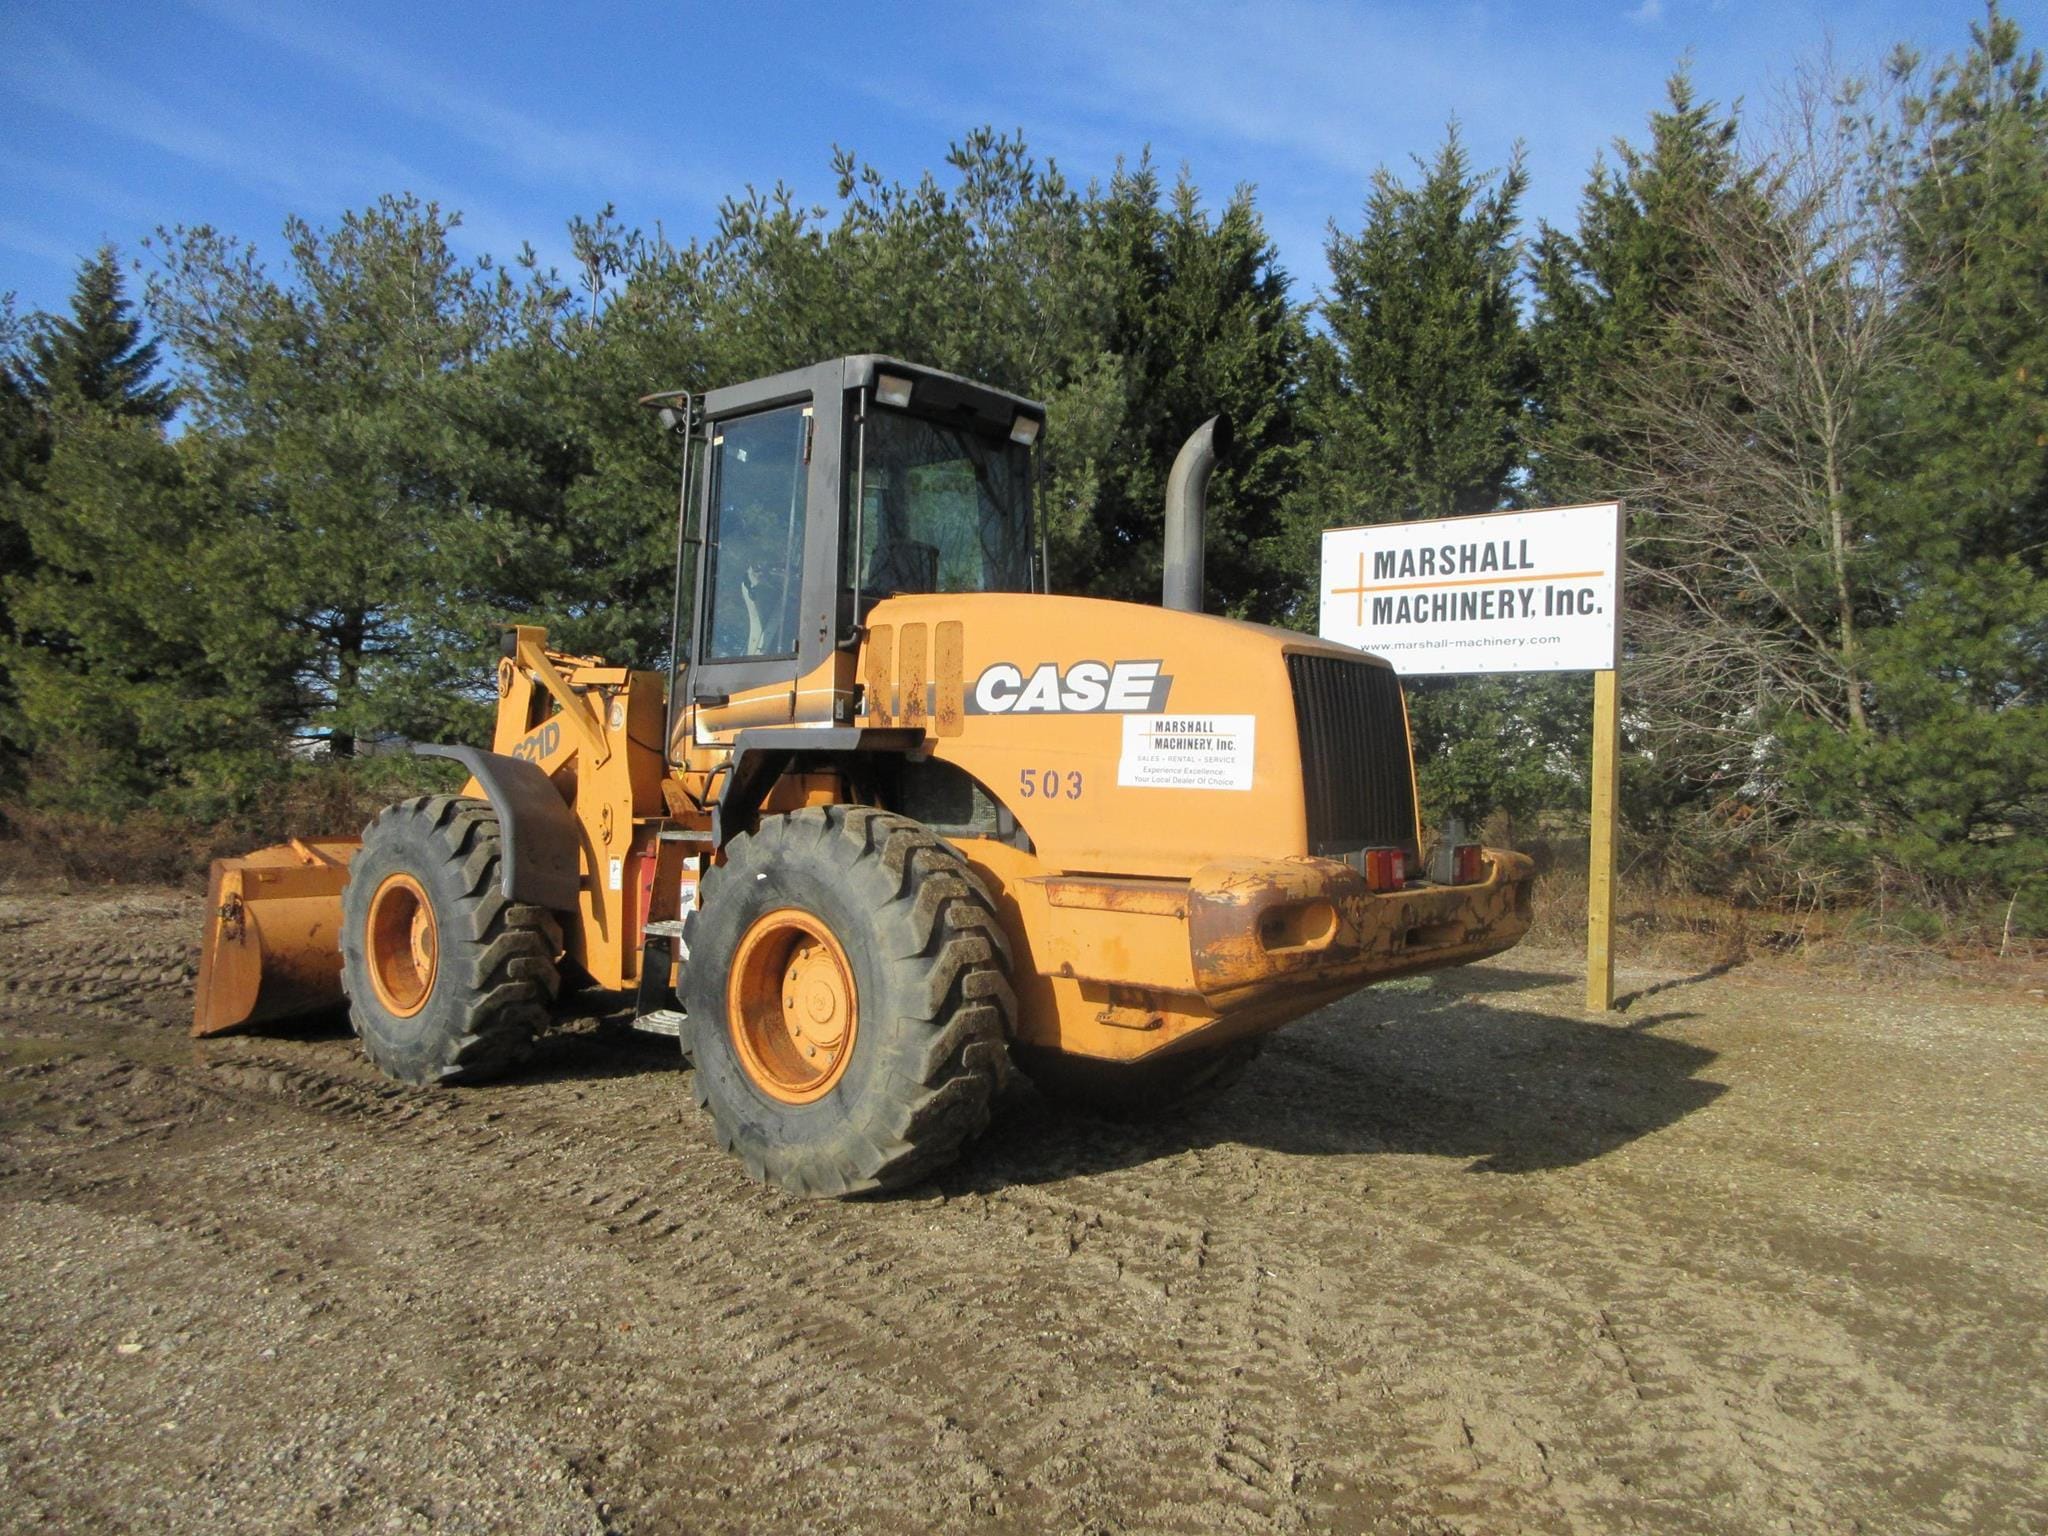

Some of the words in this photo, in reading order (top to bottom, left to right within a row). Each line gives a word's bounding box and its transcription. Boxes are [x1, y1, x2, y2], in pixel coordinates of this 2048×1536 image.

[1373, 538, 1535, 580] MARSHALL
[1372, 587, 1536, 626] MACHINERY,
[1544, 585, 1603, 617] Inc.
[1360, 634, 1561, 651] www.marshall-machinery.com
[974, 660, 1163, 713] CASE
[1155, 720, 1214, 733] MARSHALL
[1154, 737, 1214, 751] MACHINERY,
[1216, 738, 1237, 751] Inc.
[1167, 755, 1195, 763] RENTAL
[1203, 756, 1236, 764] SERVICE
[1143, 765, 1182, 775] Experience
[1020, 768, 1083, 800] 503
[1134, 775, 1150, 783] Your
[1151, 775, 1171, 784] Local
[1172, 776, 1196, 785] Dealer
[1198, 777, 1206, 785] Of
[1207, 777, 1234, 786] Choice
